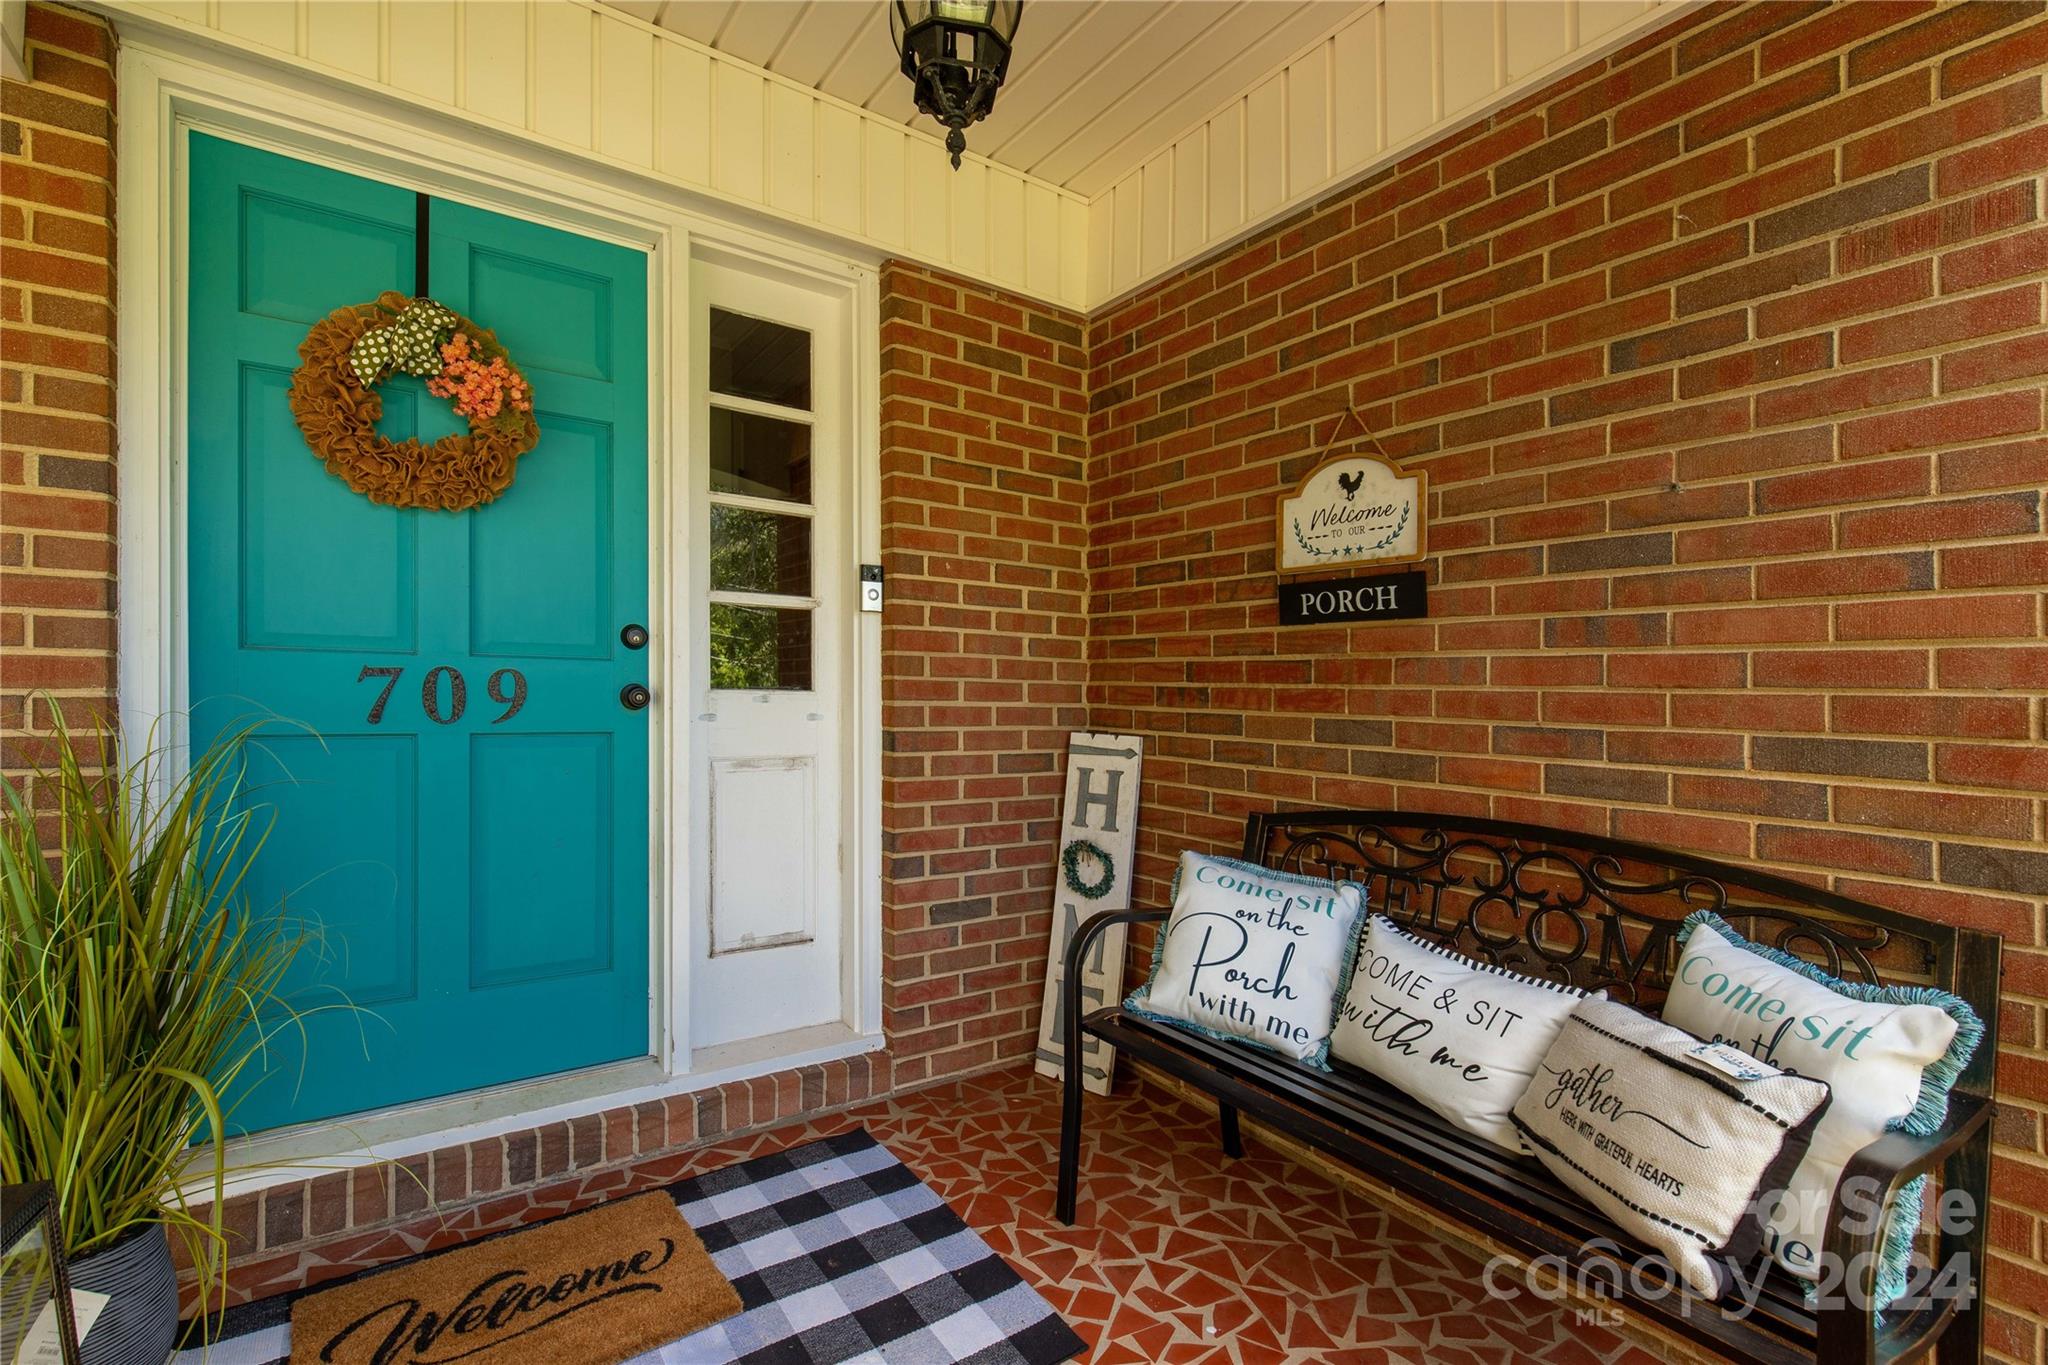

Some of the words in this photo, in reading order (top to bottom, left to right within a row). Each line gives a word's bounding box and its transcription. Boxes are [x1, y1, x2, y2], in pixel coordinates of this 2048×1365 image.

[1310, 503, 1397, 531] Welcome
[1331, 529, 1343, 538] TO
[1348, 526, 1366, 536] OUR
[1301, 584, 1399, 616] PORCH
[357, 664, 528, 725] 709
[1196, 866, 1283, 901] Come
[1296, 894, 1338, 919] sit
[1235, 907, 1263, 924] on
[1267, 897, 1309, 936] the
[1170, 911, 1298, 1001] Porch
[1199, 991, 1256, 1026] with
[1266, 1015, 1310, 1045] me
[1358, 949, 1433, 1000] COME
[1434, 988, 1458, 1014] &
[1466, 1001, 1523, 1038] SIT
[1681, 956, 1786, 1023] Come
[1794, 1015, 1875, 1061] sit
[1343, 994, 1434, 1056] with
[1430, 1046, 1488, 1081] me
[1559, 1107, 1579, 1129] HERE
[1578, 1119, 1595, 1141] WITH
[1594, 1132, 1634, 1169] GRATEFUL
[1635, 1158, 1684, 1197] HEARTS
[320, 1238, 674, 1365] Welcome
